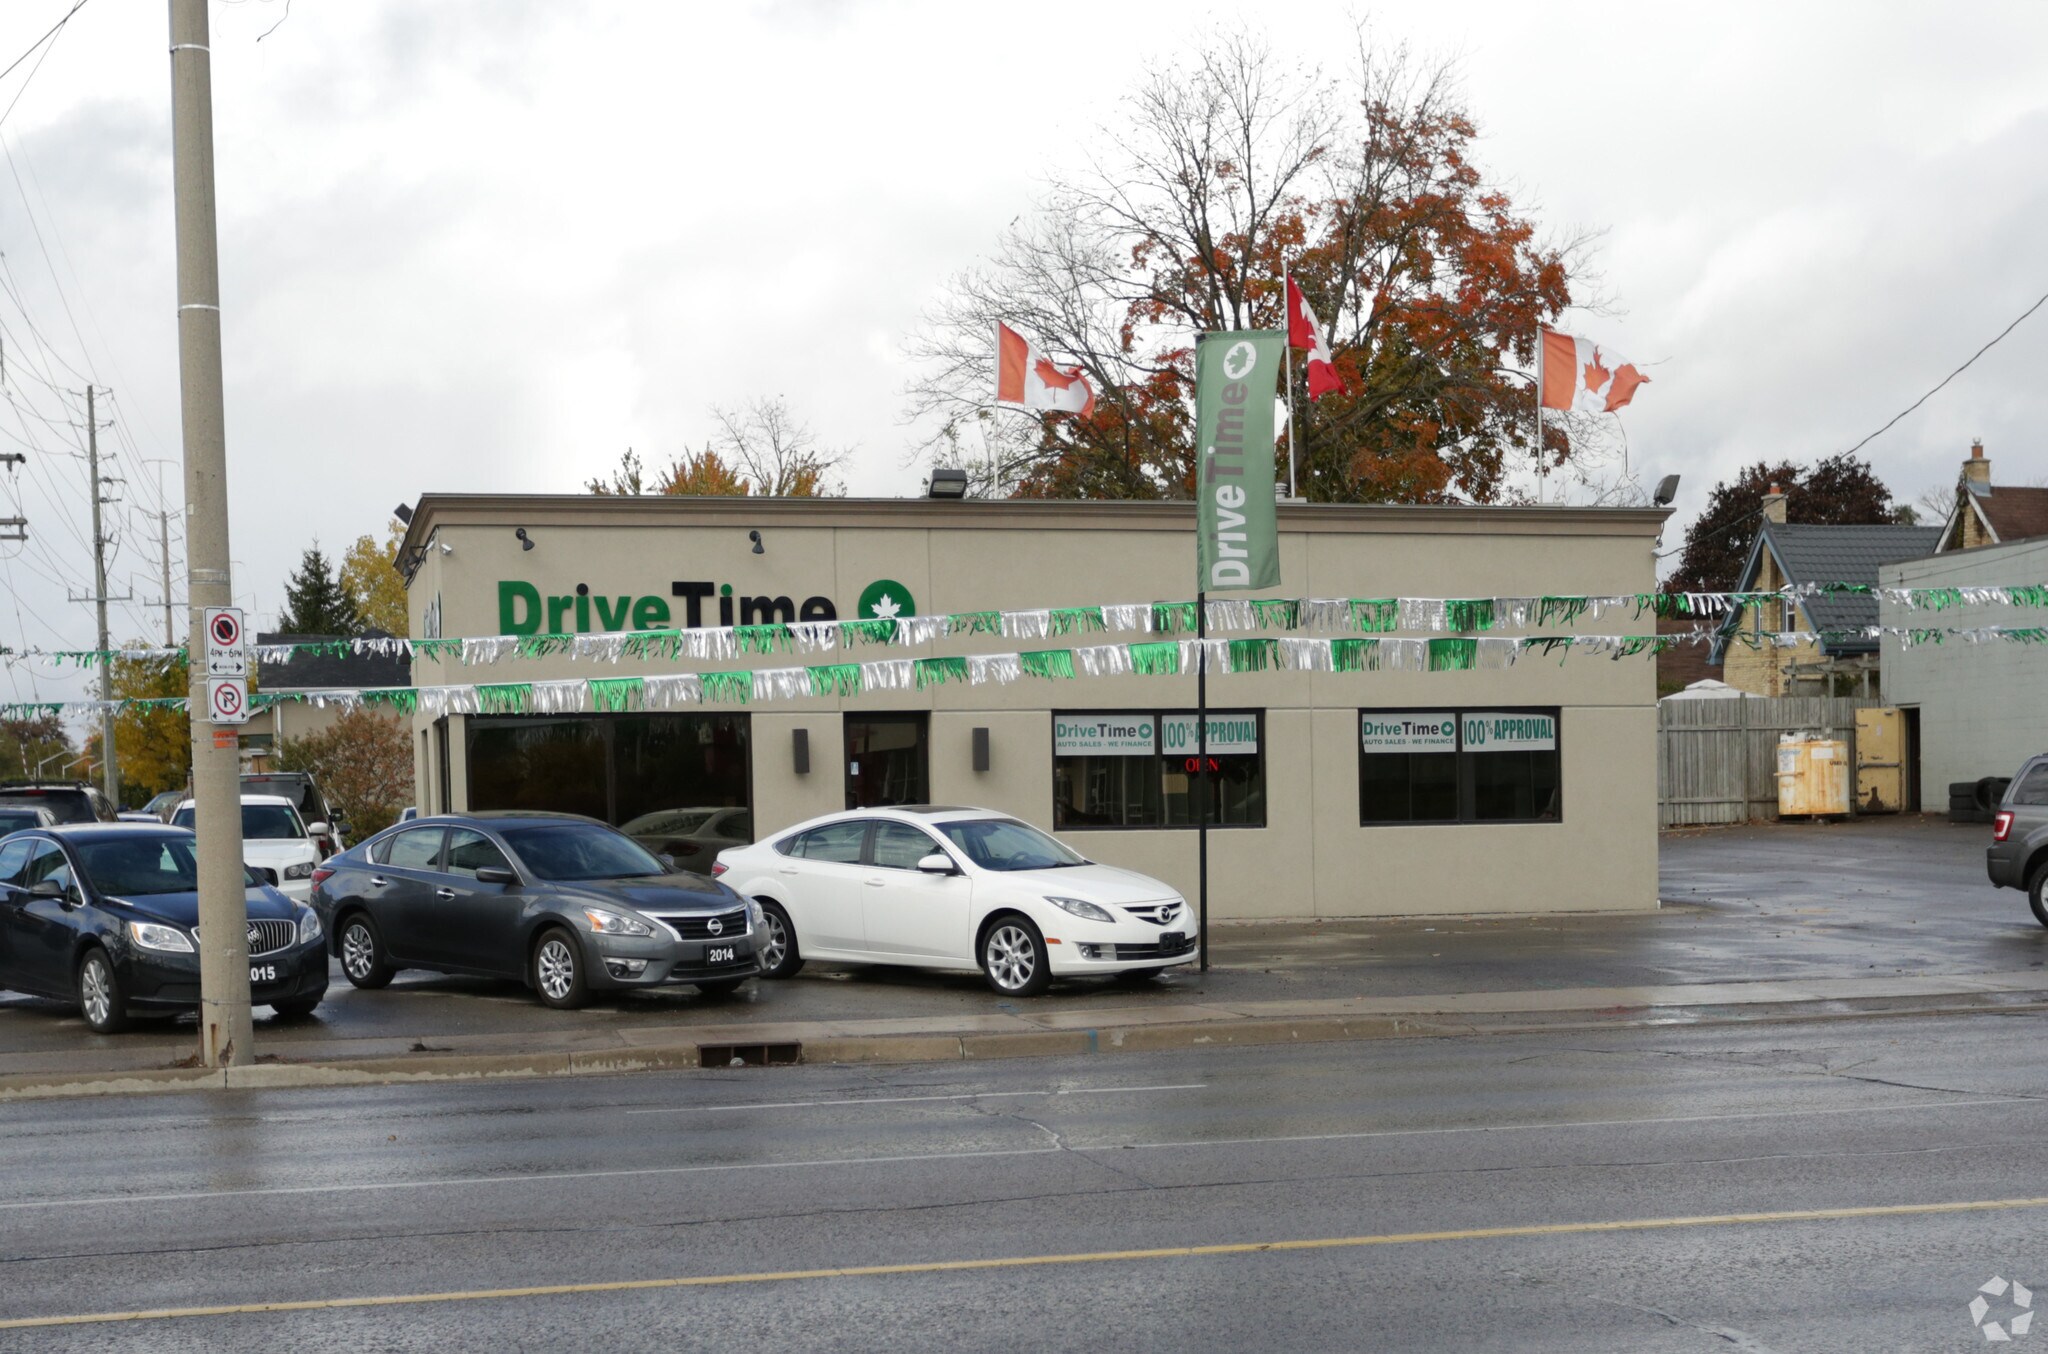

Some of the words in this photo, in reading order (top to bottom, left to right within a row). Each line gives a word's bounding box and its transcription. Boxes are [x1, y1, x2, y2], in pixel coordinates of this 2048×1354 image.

[1206, 383, 1249, 586] DriveTime
[498, 580, 838, 636] DriveTime
[1056, 723, 1137, 738] DriveTime
[1363, 721, 1440, 736] DriveTime
[1494, 719, 1553, 740] APPROVAL
[709, 948, 734, 962] 2014
[249, 966, 276, 981] 015
